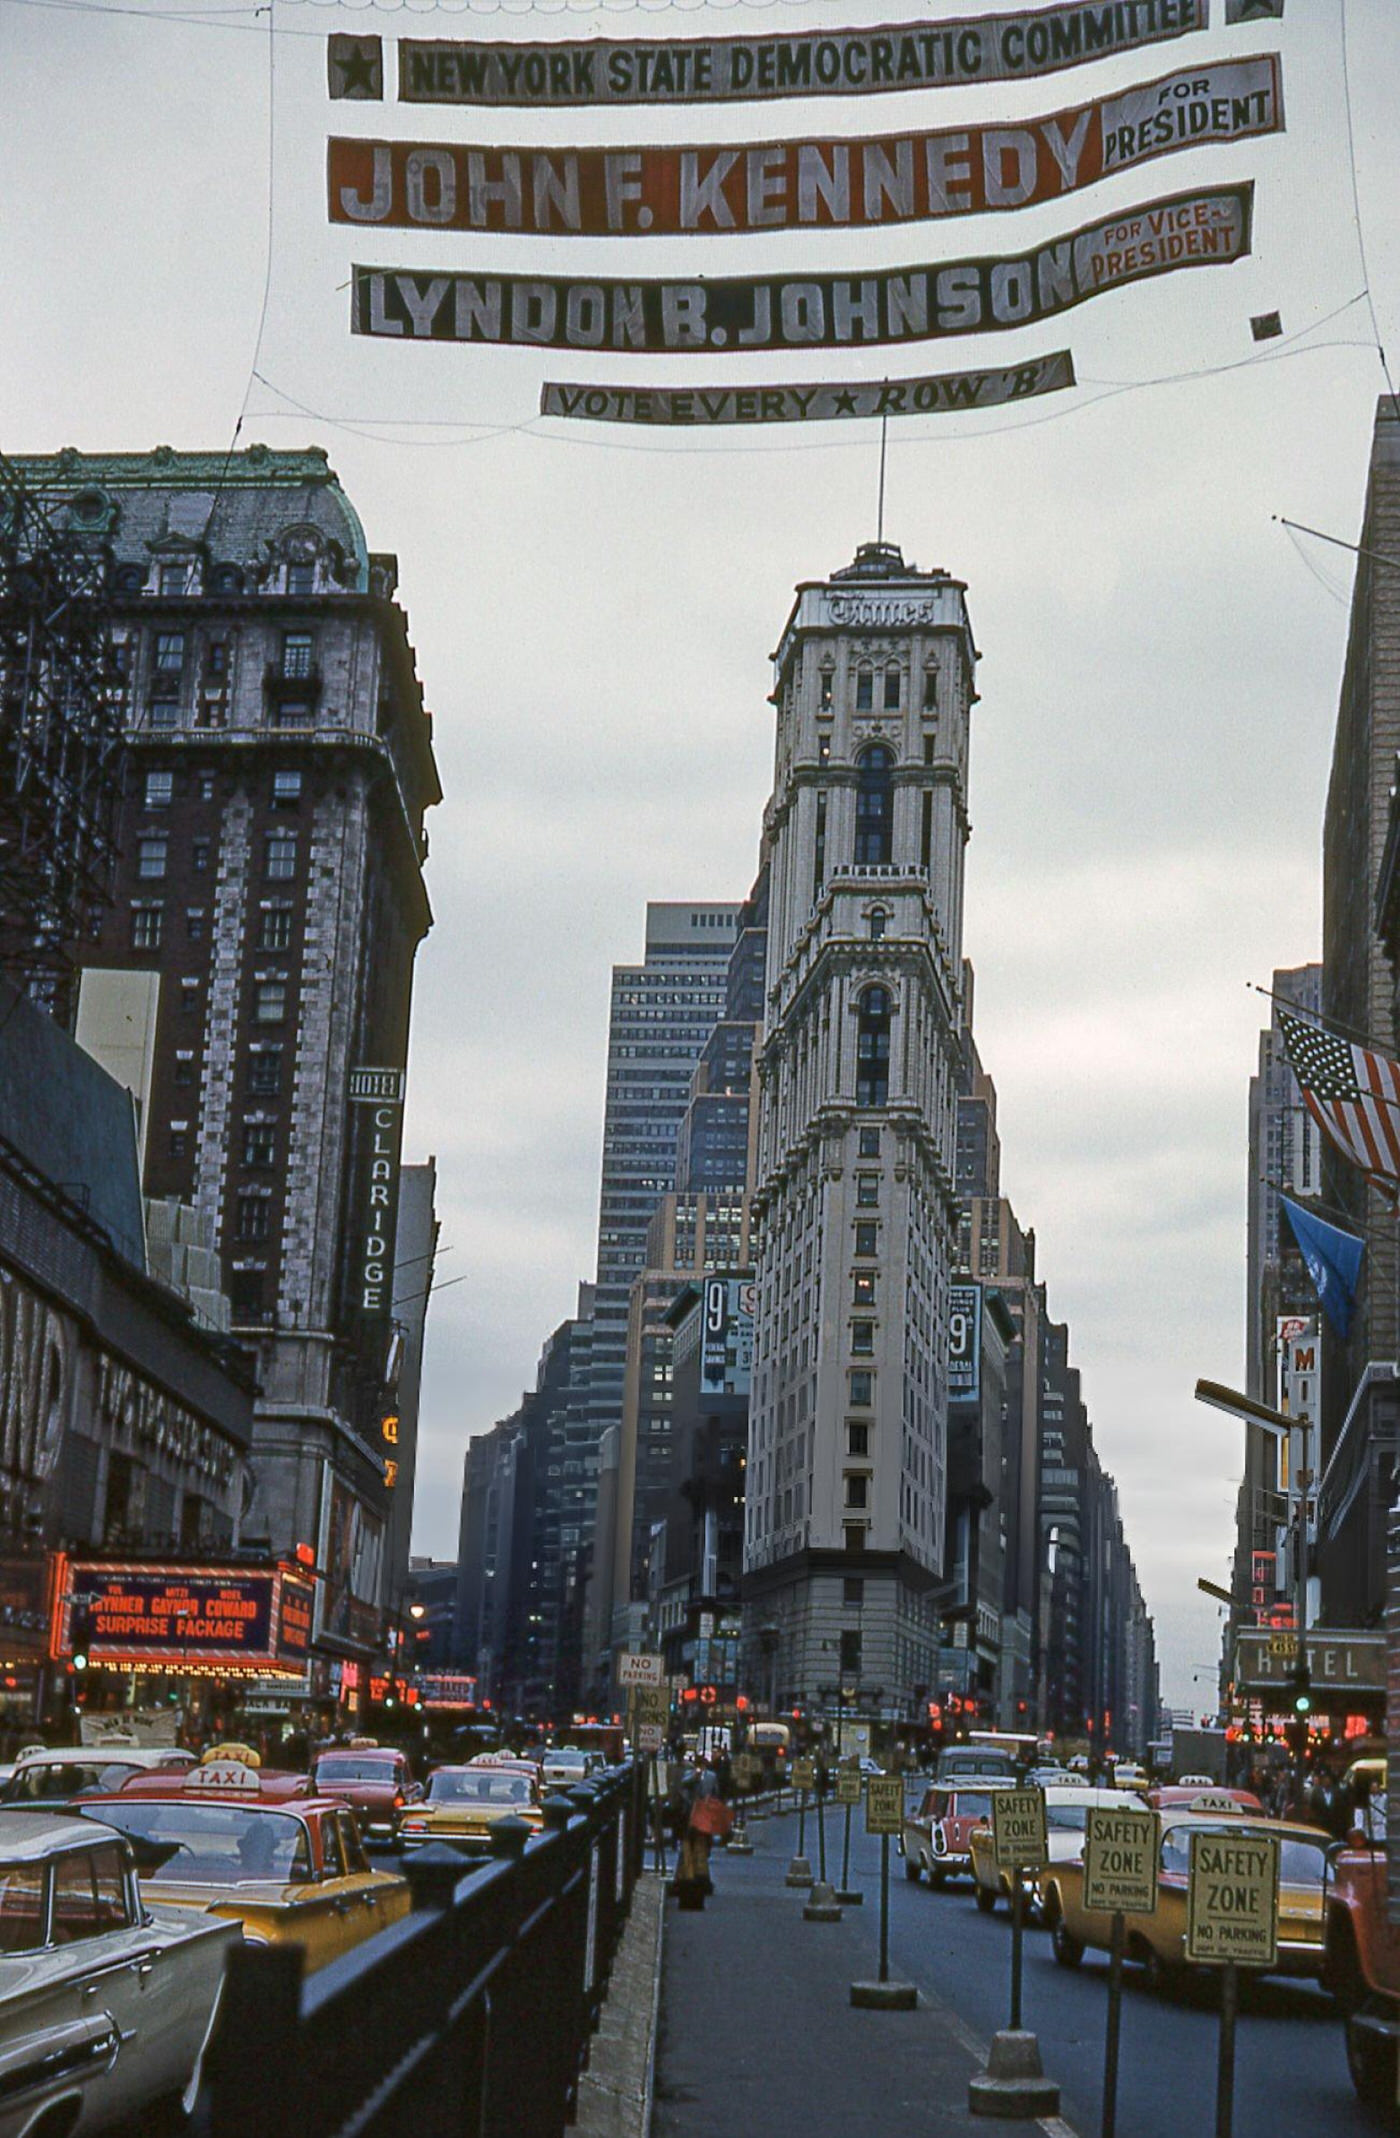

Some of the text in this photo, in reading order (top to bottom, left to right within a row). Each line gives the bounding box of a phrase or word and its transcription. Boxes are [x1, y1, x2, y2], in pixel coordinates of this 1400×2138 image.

[412, 51, 487, 94] NEW
[500, 50, 595, 93] YORK
[608, 47, 712, 93] STATE
[731, 31, 983, 89] DEMOCRATIC
[1157, 78, 1211, 105] FOR
[1105, 89, 1271, 166] PRESIDENT
[340, 109, 1094, 230] JOHN F. KENNEDY
[1104, 221, 1142, 246] FOR
[1090, 226, 1236, 284] PRESIDENT
[370, 241, 1075, 347] LYNDON B. JOHNSON
[559, 387, 818, 422] VOTE EVERY
[871, 376, 983, 414] ROW
[828, 592, 934, 626] Times
[350, 1074, 398, 1095] HOTEL
[363, 1108, 393, 1309] CLARIDGE
[708, 1282, 723, 1332] 9
[950, 1313, 967, 1355] 9
[205, 1600, 257, 1619] COWARD
[96, 1616, 169, 1637] SURPRISE
[176, 1621, 245, 1641] PACKAGE
[622, 1671, 658, 1682] PARKING
[631, 1658, 652, 1670] NO
[212, 1751, 250, 1763] TAXI
[199, 1771, 247, 1785] TAXI
[998, 1798, 1040, 1814] SAFETY
[1201, 1798, 1233, 1810] TAXI
[1004, 1819, 1036, 1837] ZONE
[1094, 1819, 1150, 1845] SAFETY
[1101, 1851, 1144, 1873] ZONE
[1200, 1847, 1269, 1878] SAFETY
[1091, 1882, 1149, 1898] NO PARKING
[1207, 1884, 1260, 1913] ZONE
[1197, 1924, 1267, 1943] NO PARKING
